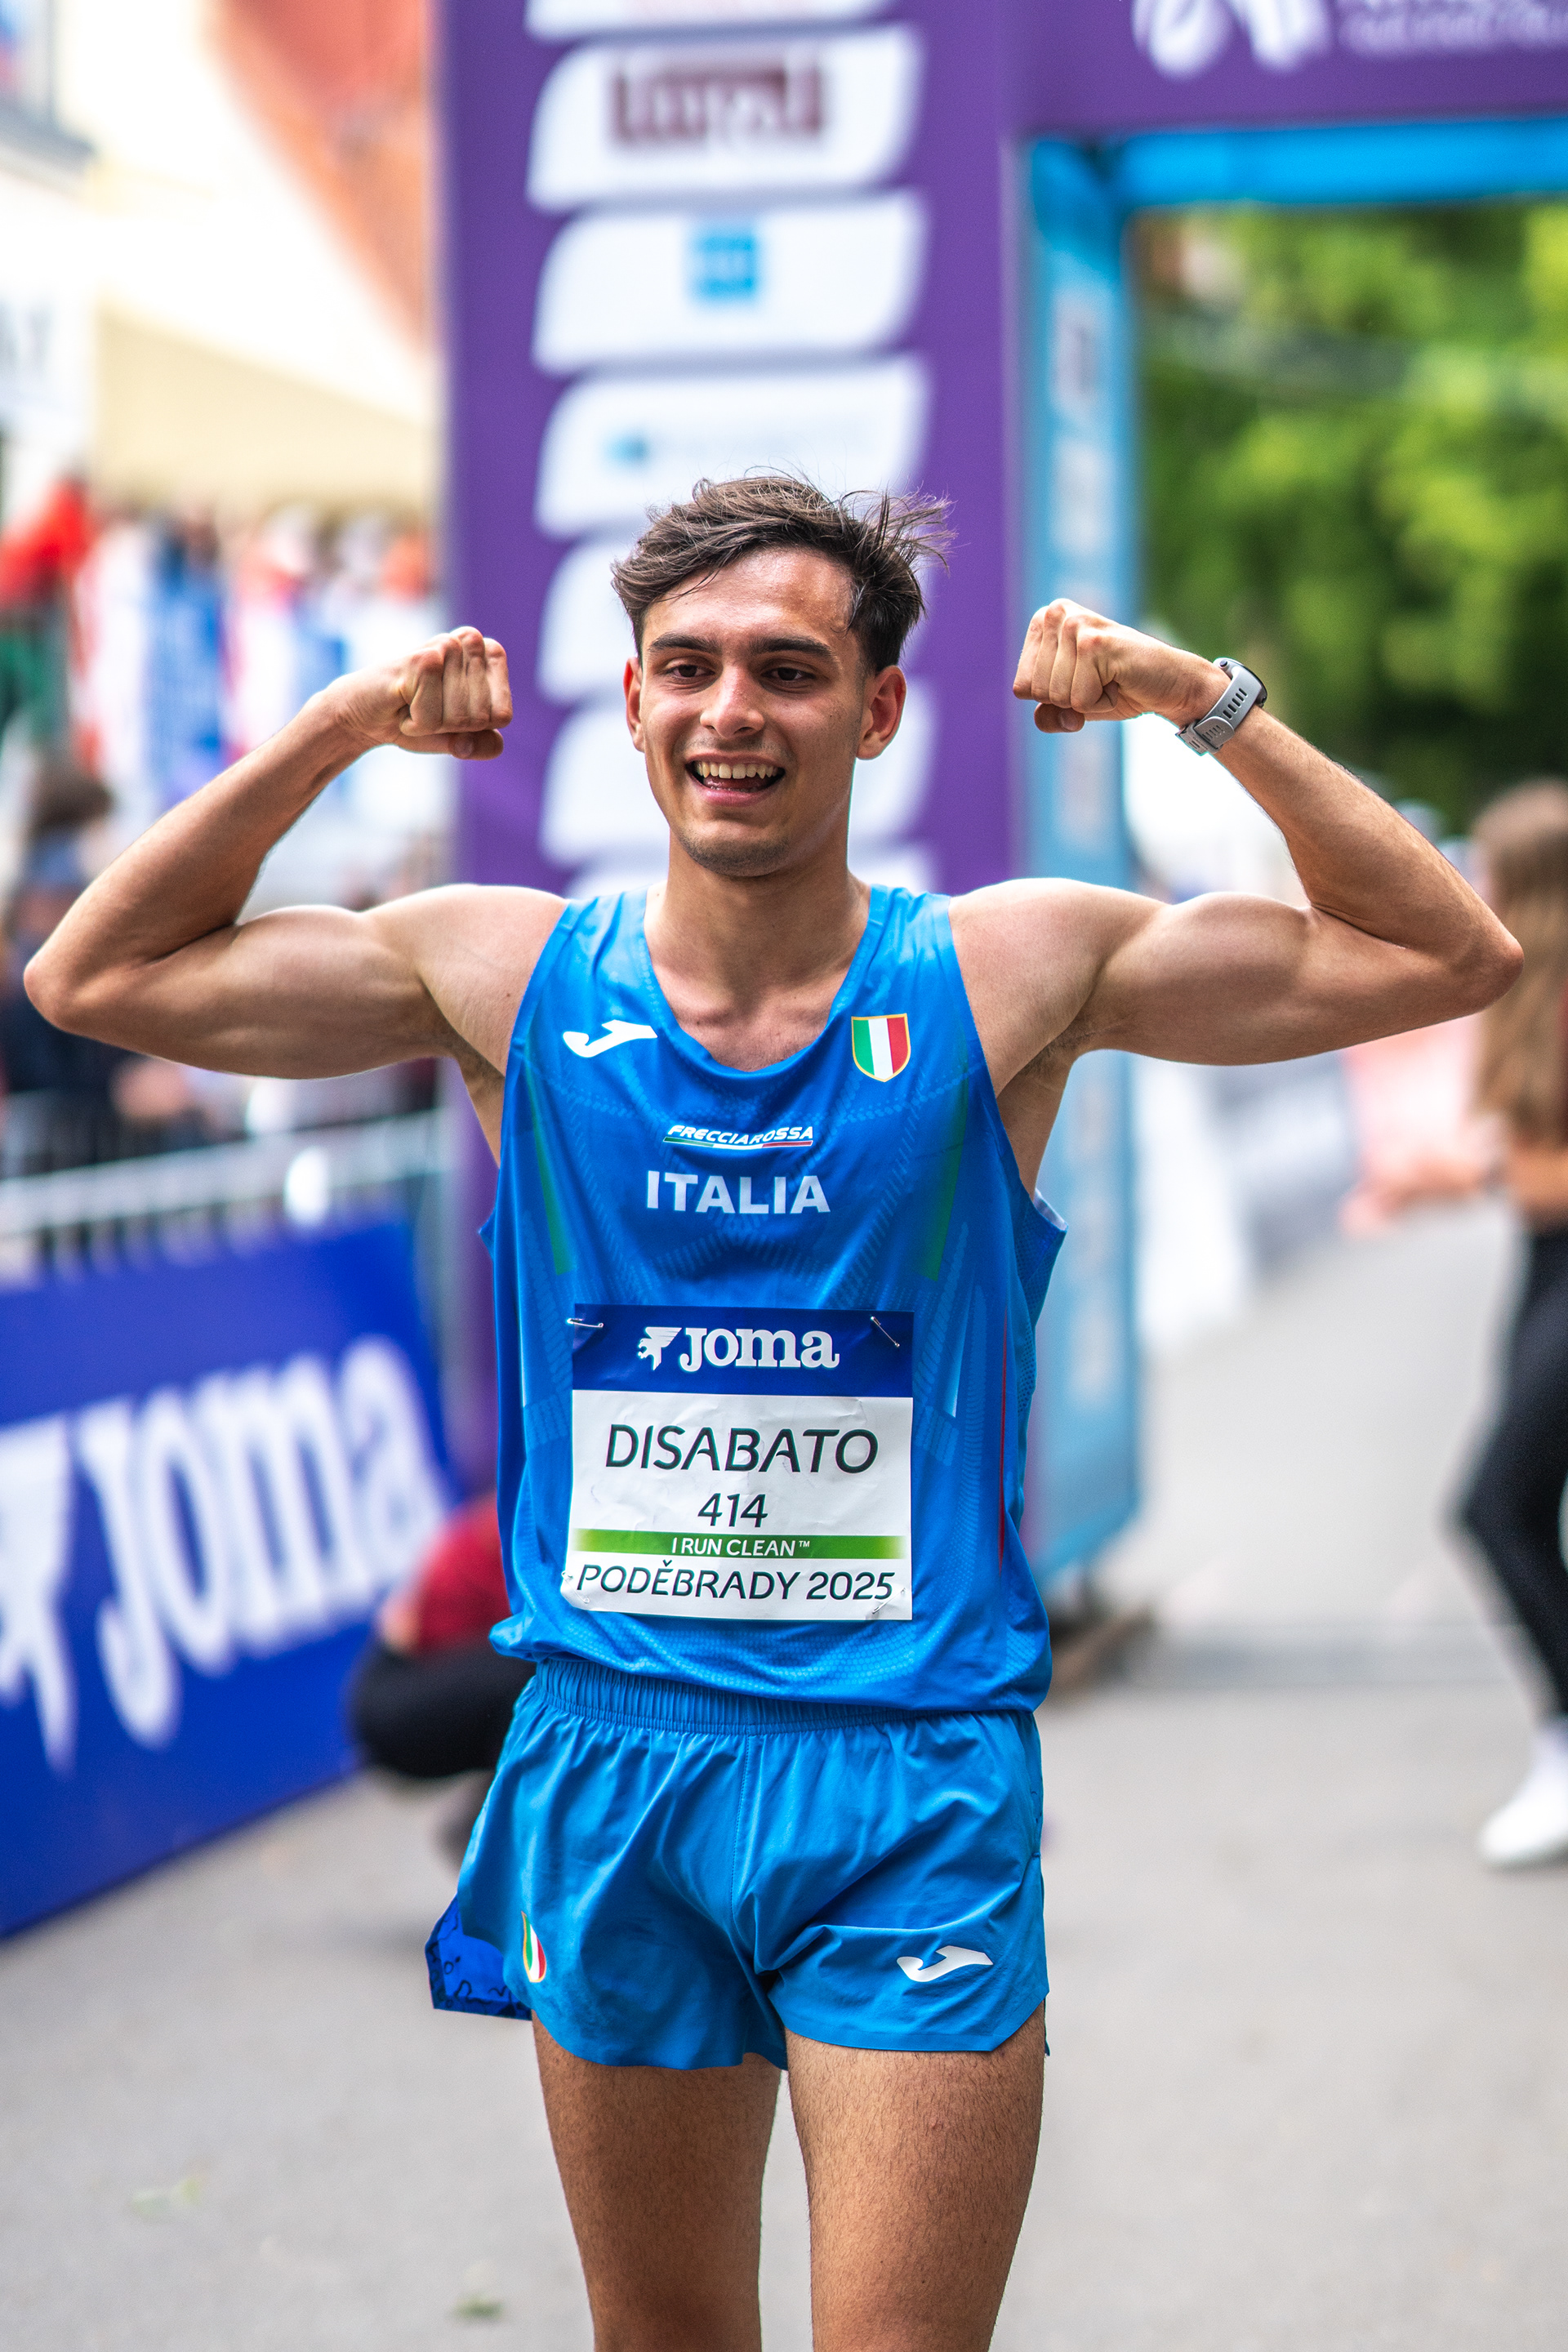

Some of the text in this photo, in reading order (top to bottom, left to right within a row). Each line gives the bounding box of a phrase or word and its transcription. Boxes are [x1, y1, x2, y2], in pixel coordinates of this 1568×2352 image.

[667, 1125, 813, 1145] FRECCIAROSSA
[646, 1169, 831, 1214] ITALIA
[605, 1423, 880, 1474] DISABATO
[697, 1492, 768, 1528] 414
[671, 1536, 679, 1553] I
[681, 1537, 722, 1556] RUN
[577, 1559, 896, 1601] PODĚBRADY 2025
